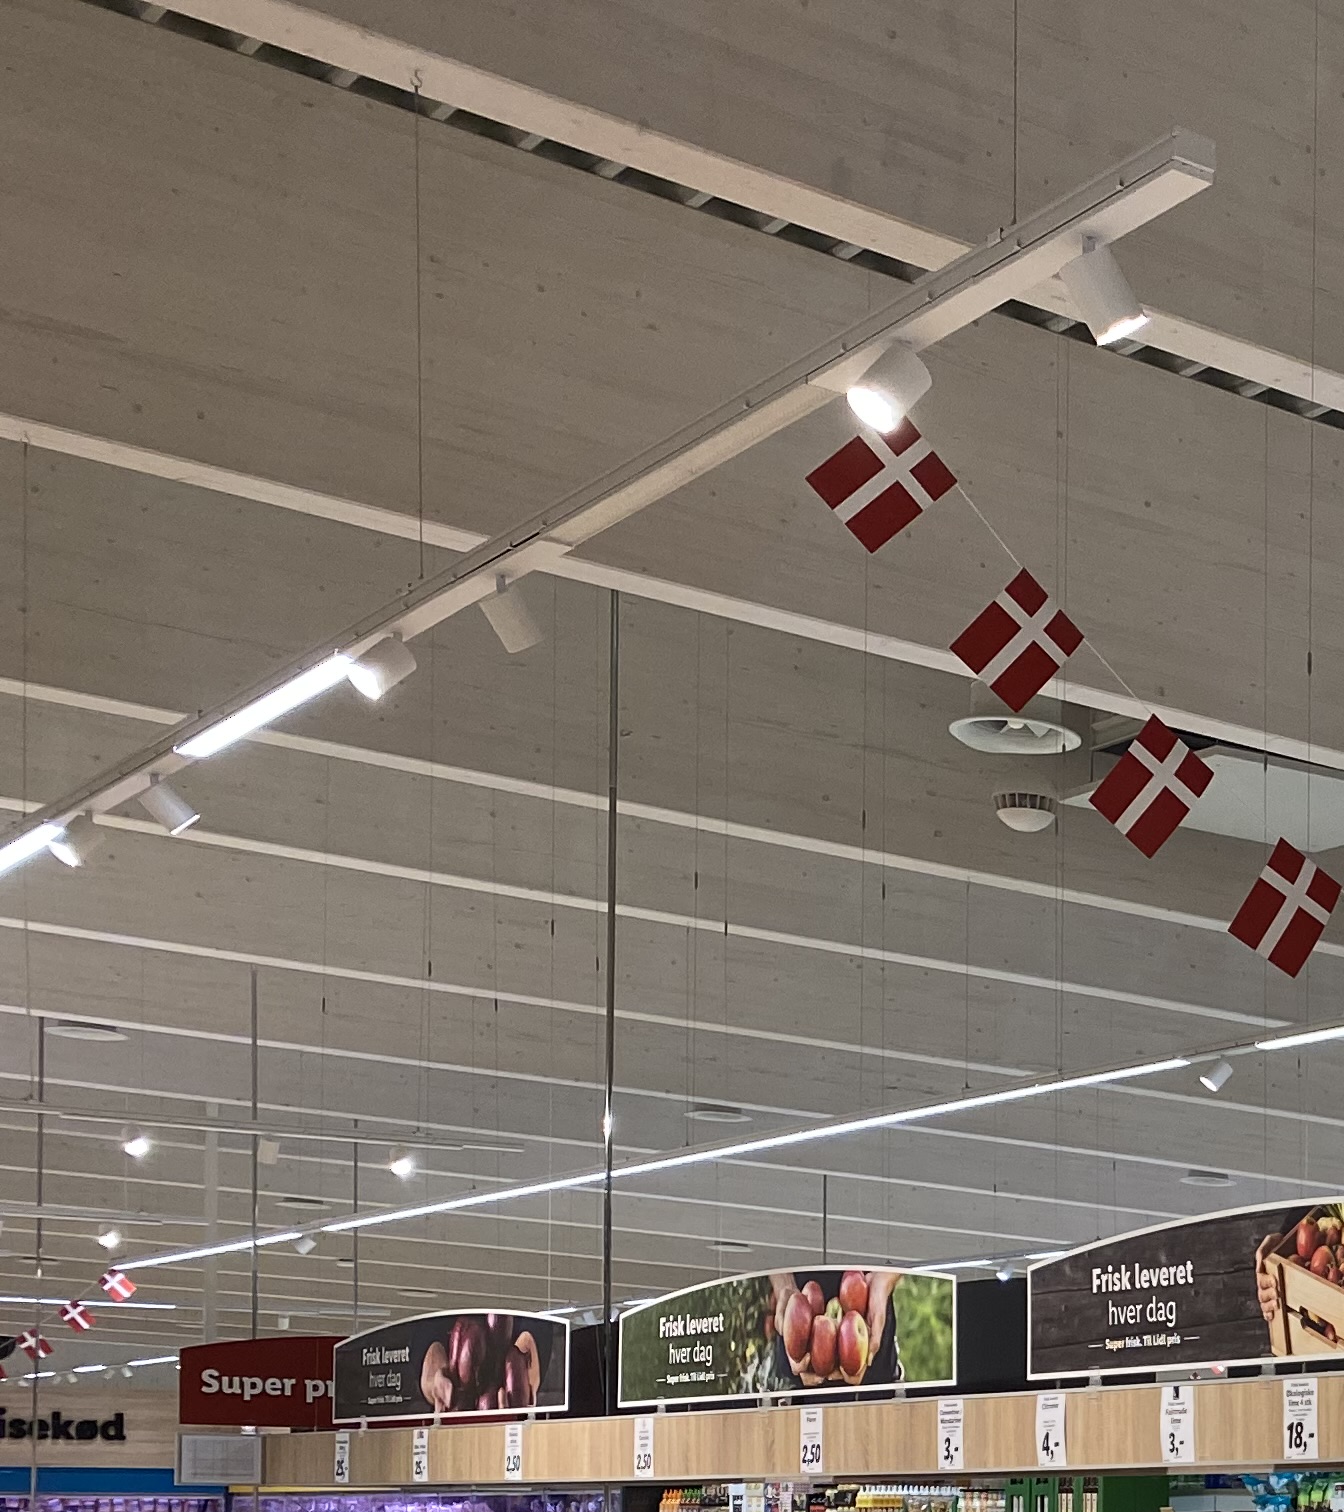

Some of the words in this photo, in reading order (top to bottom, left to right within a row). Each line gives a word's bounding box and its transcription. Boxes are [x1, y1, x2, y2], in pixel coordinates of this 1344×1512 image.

[1092, 1265, 1131, 1293] Frisk
[1134, 1260, 1193, 1289] leveret
[1108, 1300, 1142, 1325] hver
[1146, 1296, 1177, 1327] dag
[660, 1315, 684, 1338] Frisk
[687, 1313, 724, 1335] leveret
[363, 1347, 380, 1365] Frisk
[382, 1346, 409, 1363] leveret
[669, 1343, 691, 1364] hver
[693, 1341, 712, 1366] dag
[1105, 1339, 1124, 1351] Super
[201, 1369, 295, 1400] Super
[1042, 1432, 1059, 1460] 4,-
[1169, 1433, 1184, 1455] 3,-
[1287, 1422, 1314, 1452] 18,-
[802, 1444, 820, 1465] 2,50
[944, 1437, 958, 1464] 3,-
